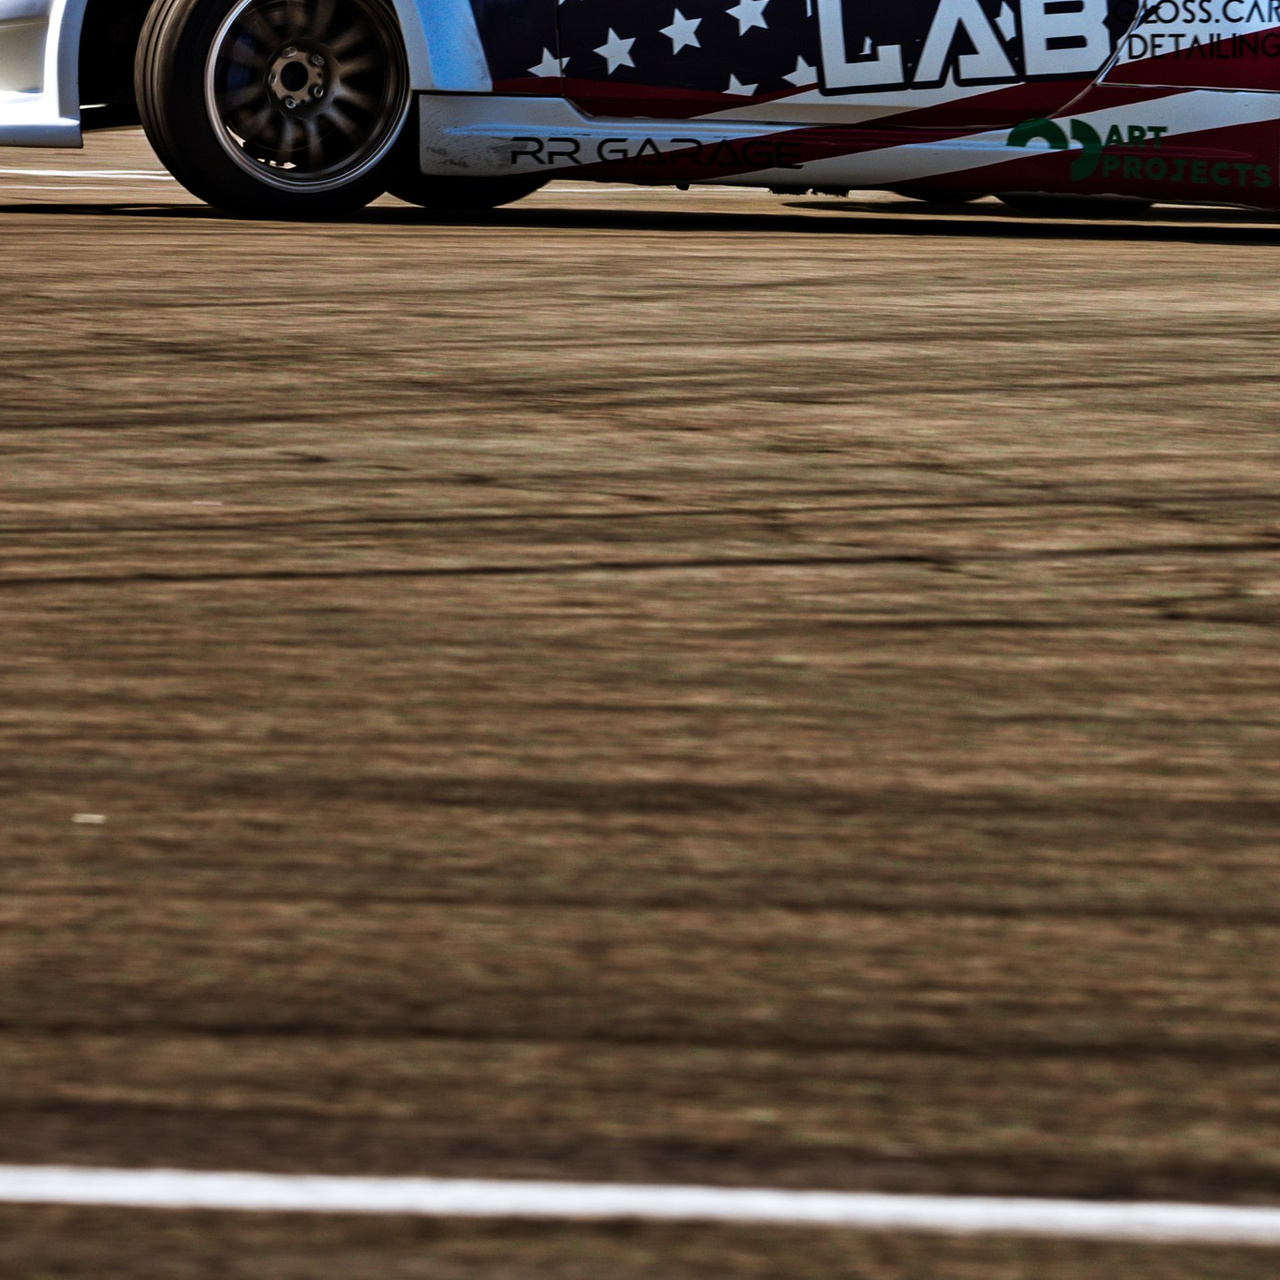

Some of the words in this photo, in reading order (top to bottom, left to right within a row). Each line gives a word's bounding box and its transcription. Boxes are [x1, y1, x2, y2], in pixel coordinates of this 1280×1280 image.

[510, 137, 582, 165] RR
[598, 137, 804, 170] GARAGE
[1105, 124, 1168, 150] ART
[1102, 154, 1272, 189] PROJECTS
